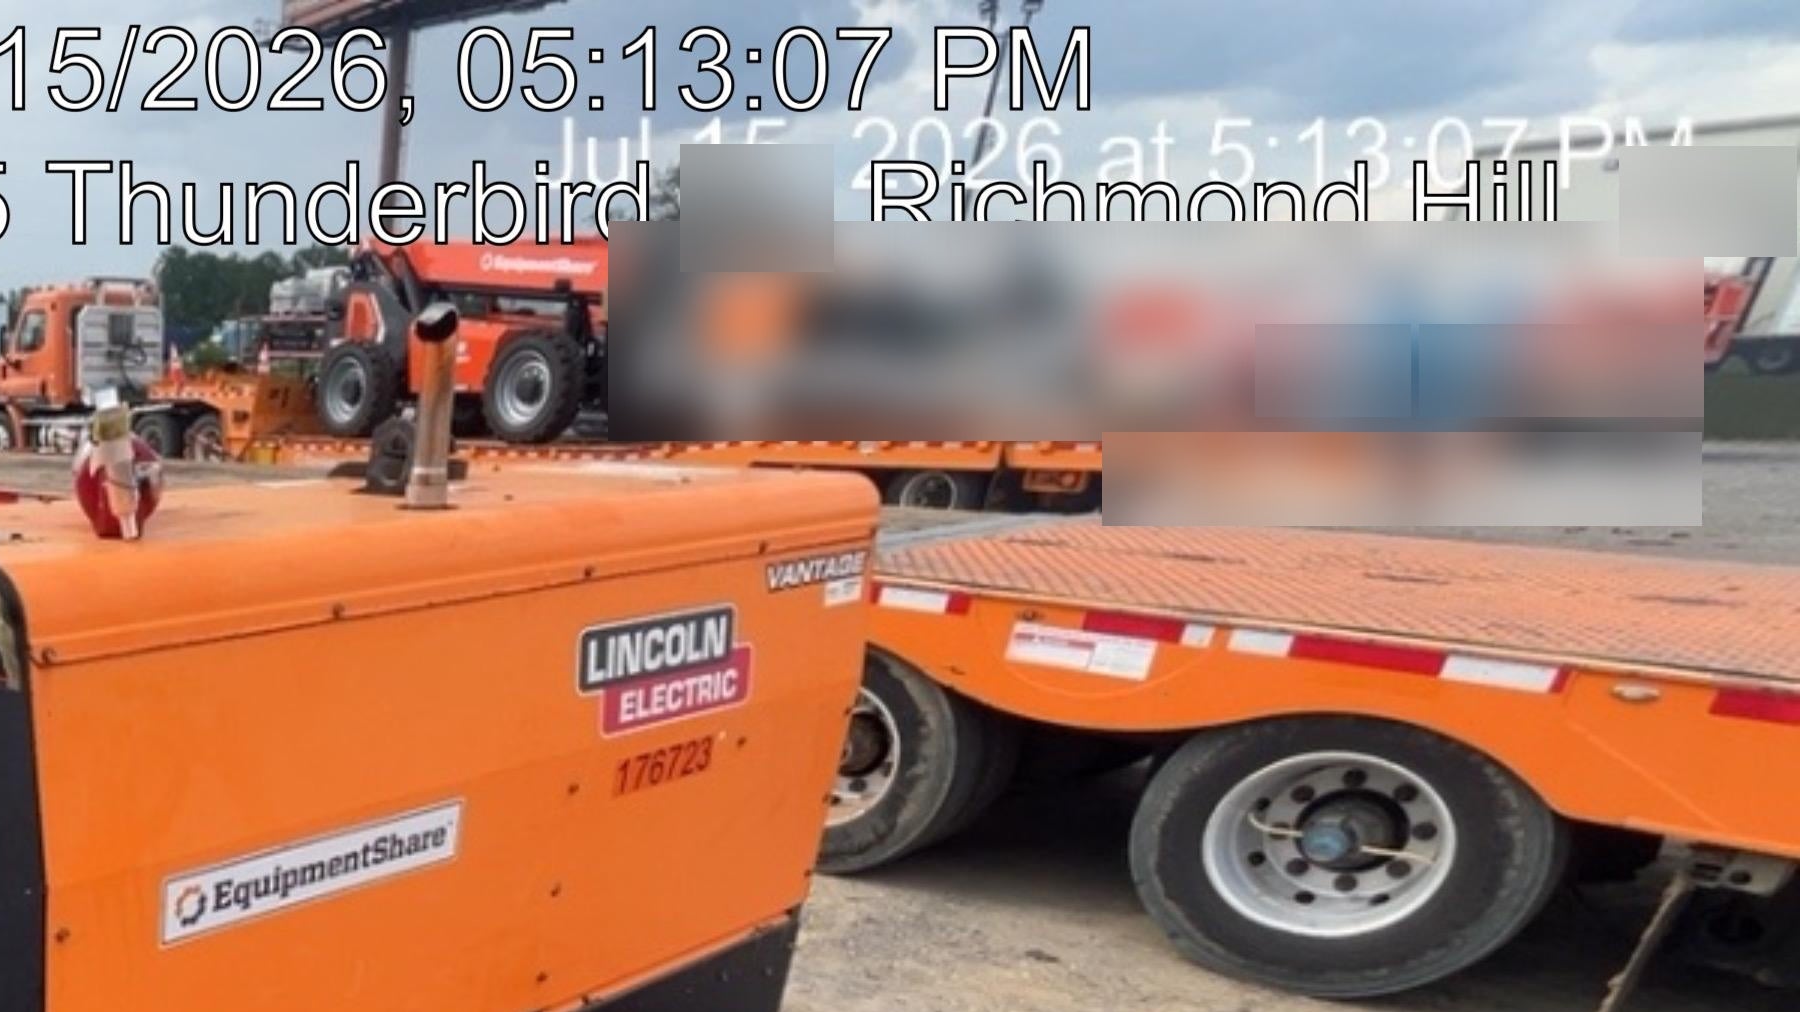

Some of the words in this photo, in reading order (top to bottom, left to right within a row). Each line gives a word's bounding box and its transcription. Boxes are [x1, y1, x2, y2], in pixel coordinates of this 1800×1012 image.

[767, 551, 867, 589] VANTAGE
[586, 615, 728, 685] LINCOLN
[618, 668, 739, 724] ELECTRIC
[615, 735, 714, 797] 176723
[212, 823, 448, 912] EquipmentShare
